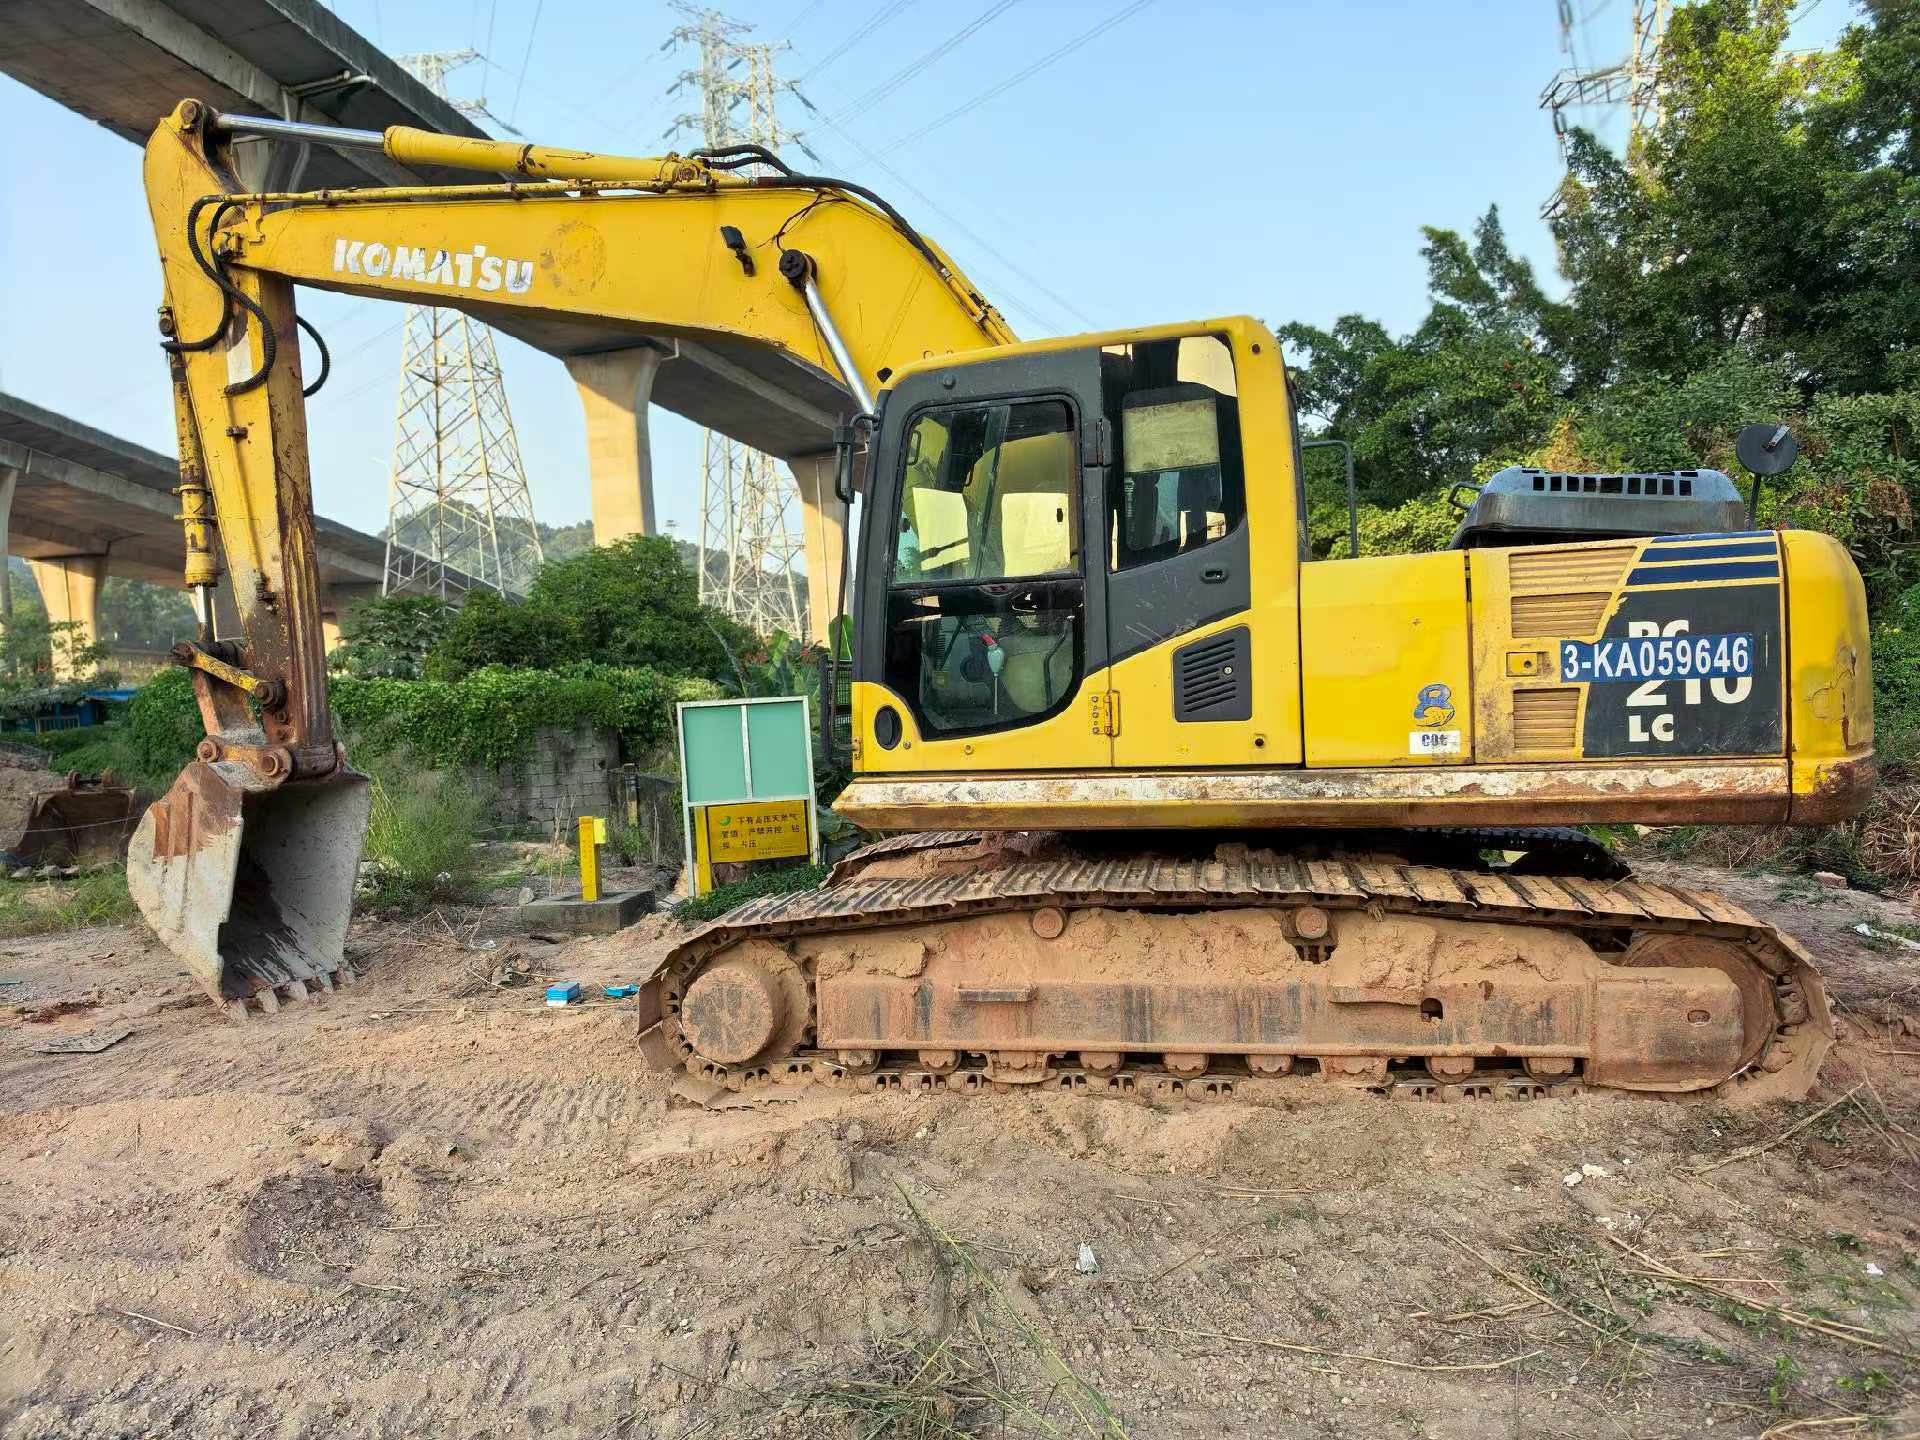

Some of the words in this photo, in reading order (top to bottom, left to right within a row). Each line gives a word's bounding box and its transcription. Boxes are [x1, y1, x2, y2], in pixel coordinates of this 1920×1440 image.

[333, 239, 534, 293] KOMATSU
[1564, 637, 1749, 679] 3-KA059646
[1628, 714, 1674, 742] LC
